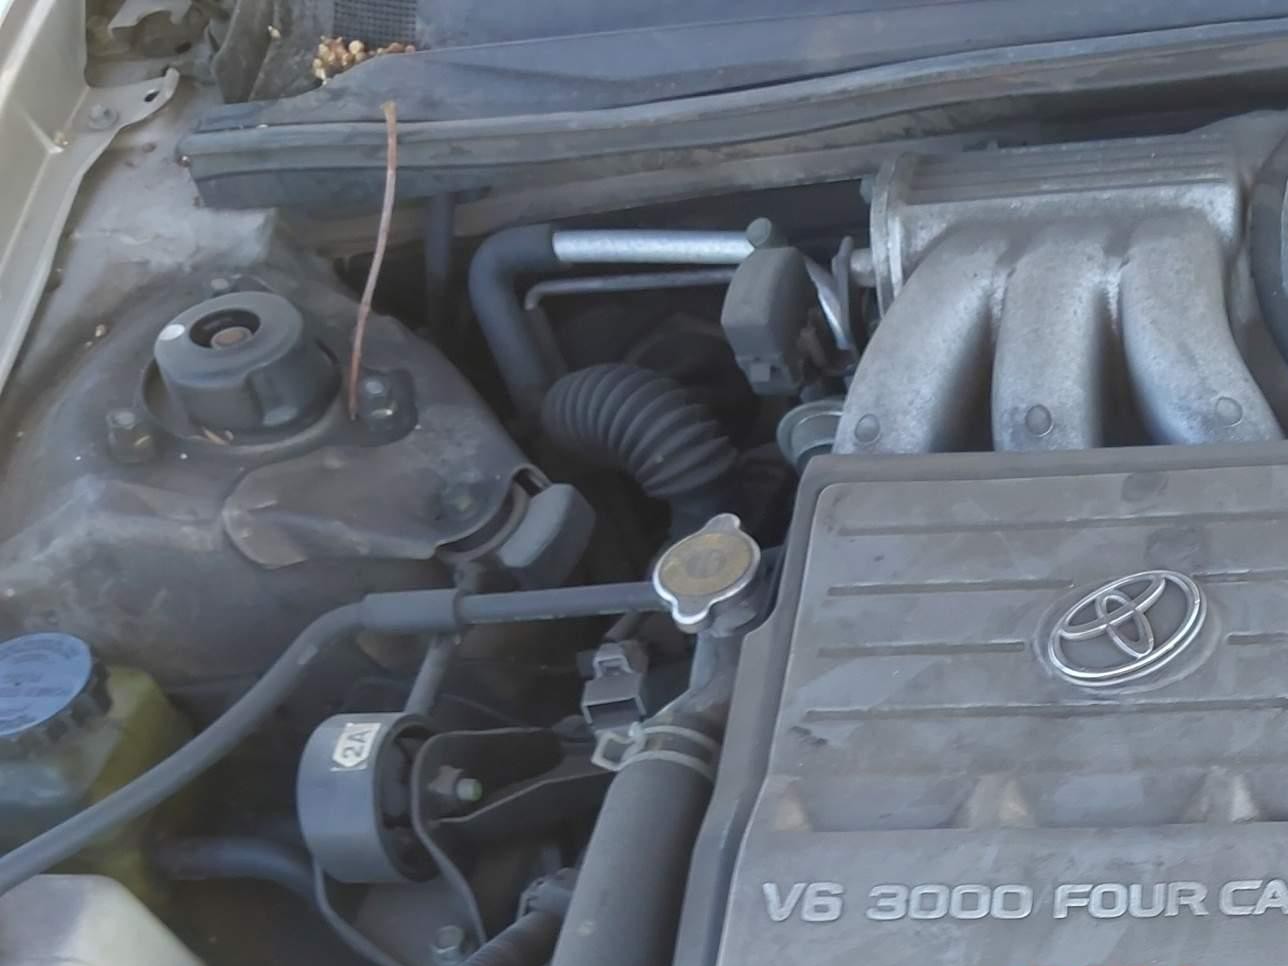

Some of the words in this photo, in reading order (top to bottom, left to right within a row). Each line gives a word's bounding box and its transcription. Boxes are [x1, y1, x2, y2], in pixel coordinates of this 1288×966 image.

[762, 881, 845, 922] V6
[865, 883, 1034, 921] 3000
[1053, 880, 1209, 919] FOUR
